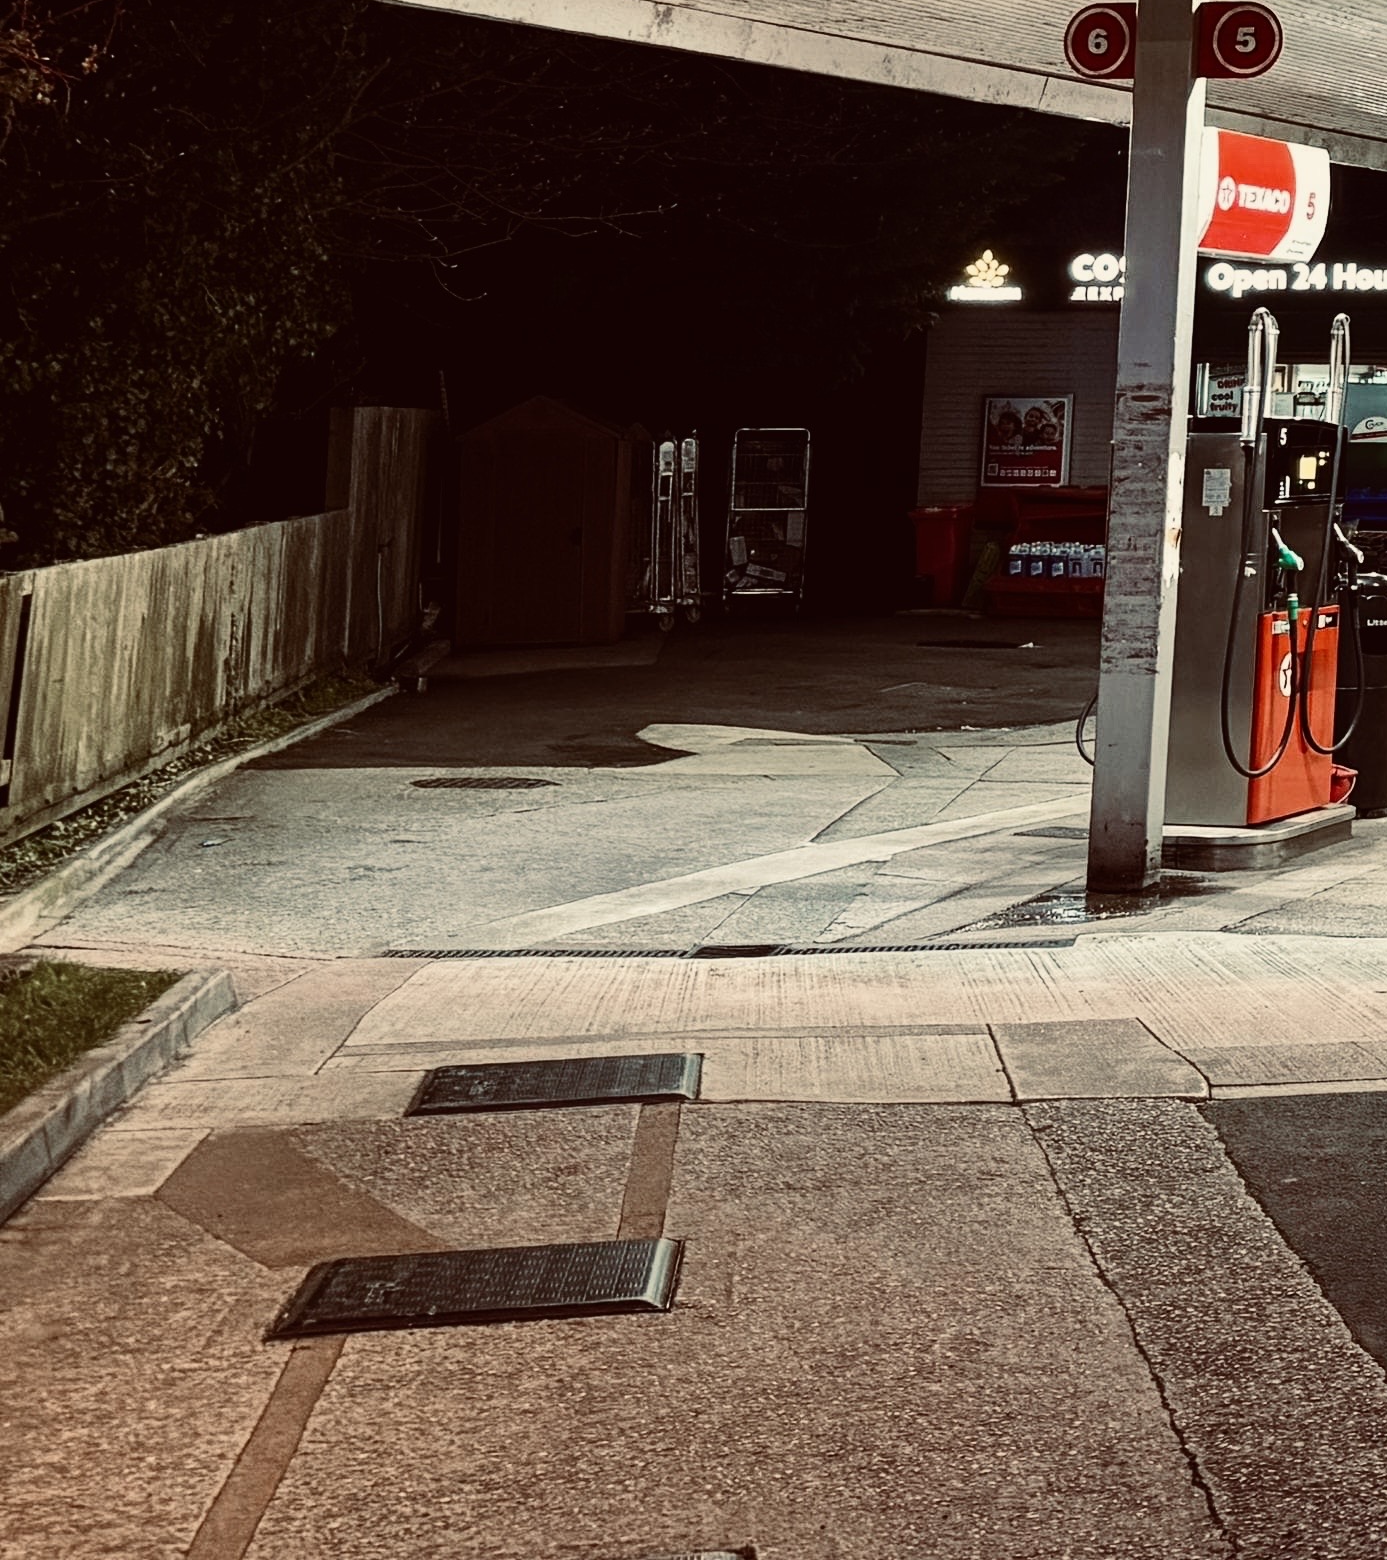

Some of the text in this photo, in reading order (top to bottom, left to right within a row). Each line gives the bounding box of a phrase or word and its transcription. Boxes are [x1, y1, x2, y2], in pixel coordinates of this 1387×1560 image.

[1087, 28, 1109, 54] 6
[1234, 27, 1256, 53] 5
[1306, 191, 1316, 220] 5
[1207, 262, 1287, 297] Open
[1291, 263, 1328, 290] 24
[1211, 390, 1233, 401] cool
[1279, 427, 1288, 446] 5
